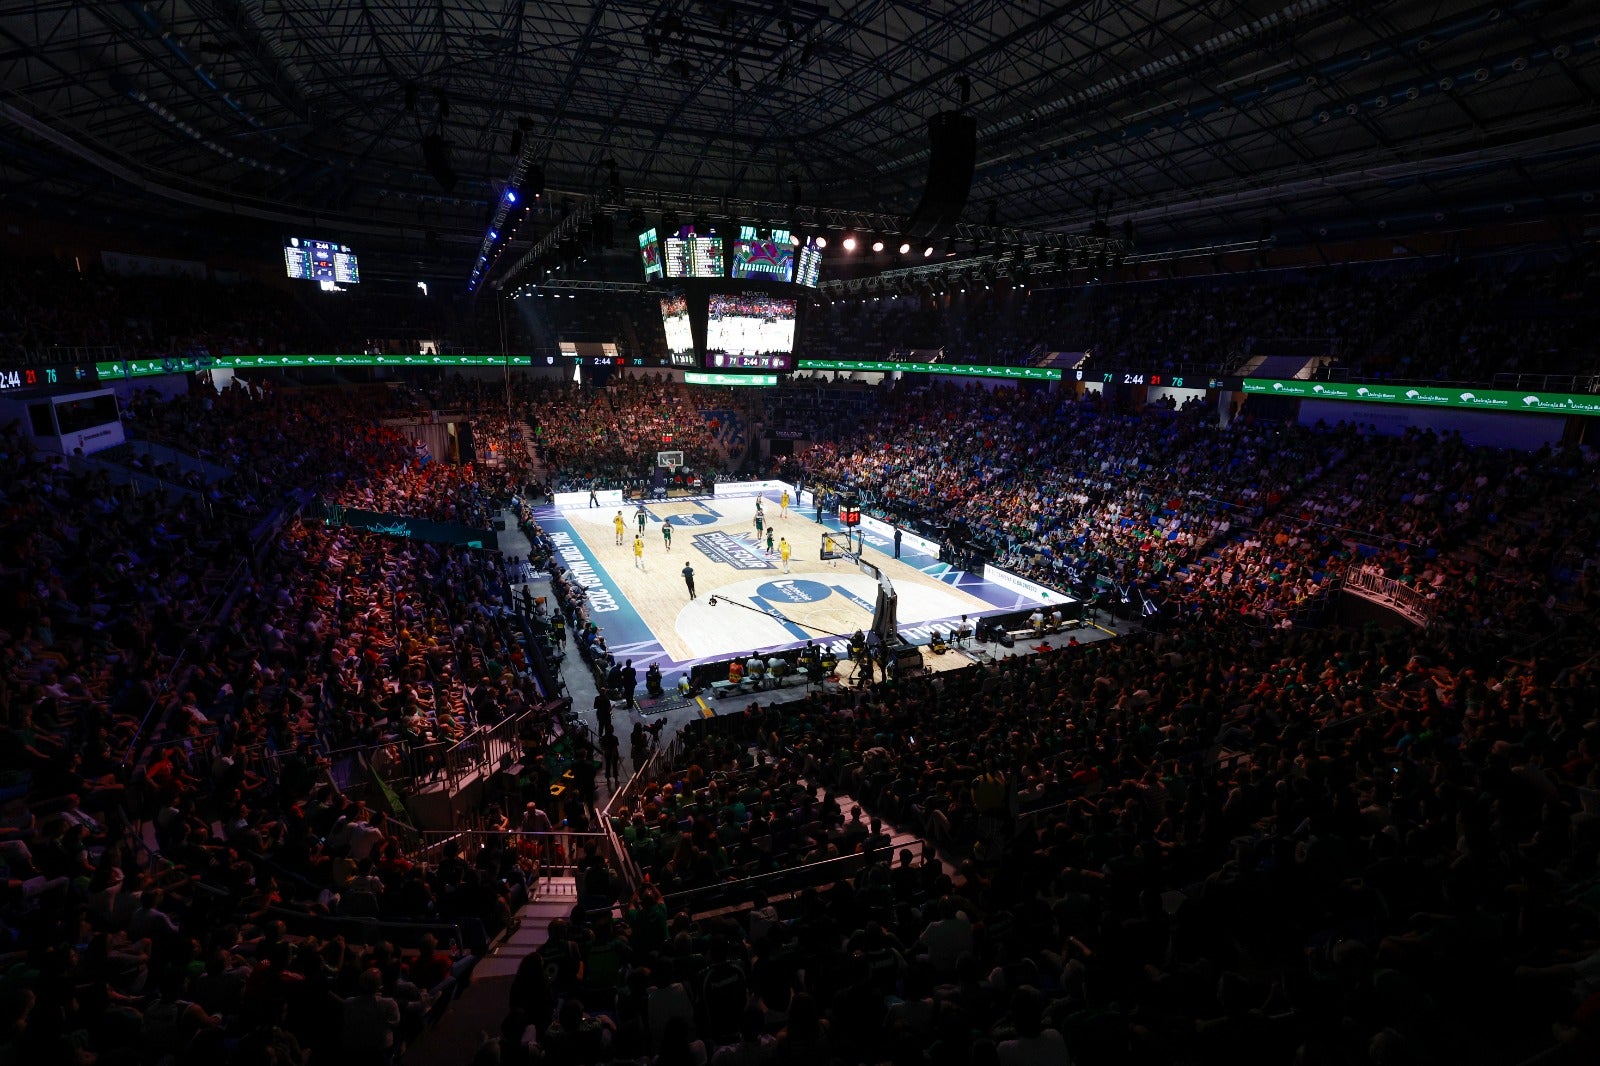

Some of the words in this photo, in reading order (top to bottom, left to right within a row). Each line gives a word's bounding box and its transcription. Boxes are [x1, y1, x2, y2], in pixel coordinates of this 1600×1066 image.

[744, 358, 758, 366] 2:44
[46, 368, 56, 383] 76
[1103, 374, 1113, 383] 71
[1124, 374, 1144, 385] 2:44
[1151, 375, 1161, 384] 21
[1171, 377, 1184, 387] 76
[849, 513, 858, 522] 21
[705, 532, 738, 550] FINAL
[728, 550, 767, 568] FOUR
[557, 546, 584, 562] FOUR
[585, 588, 620, 613] 2023
